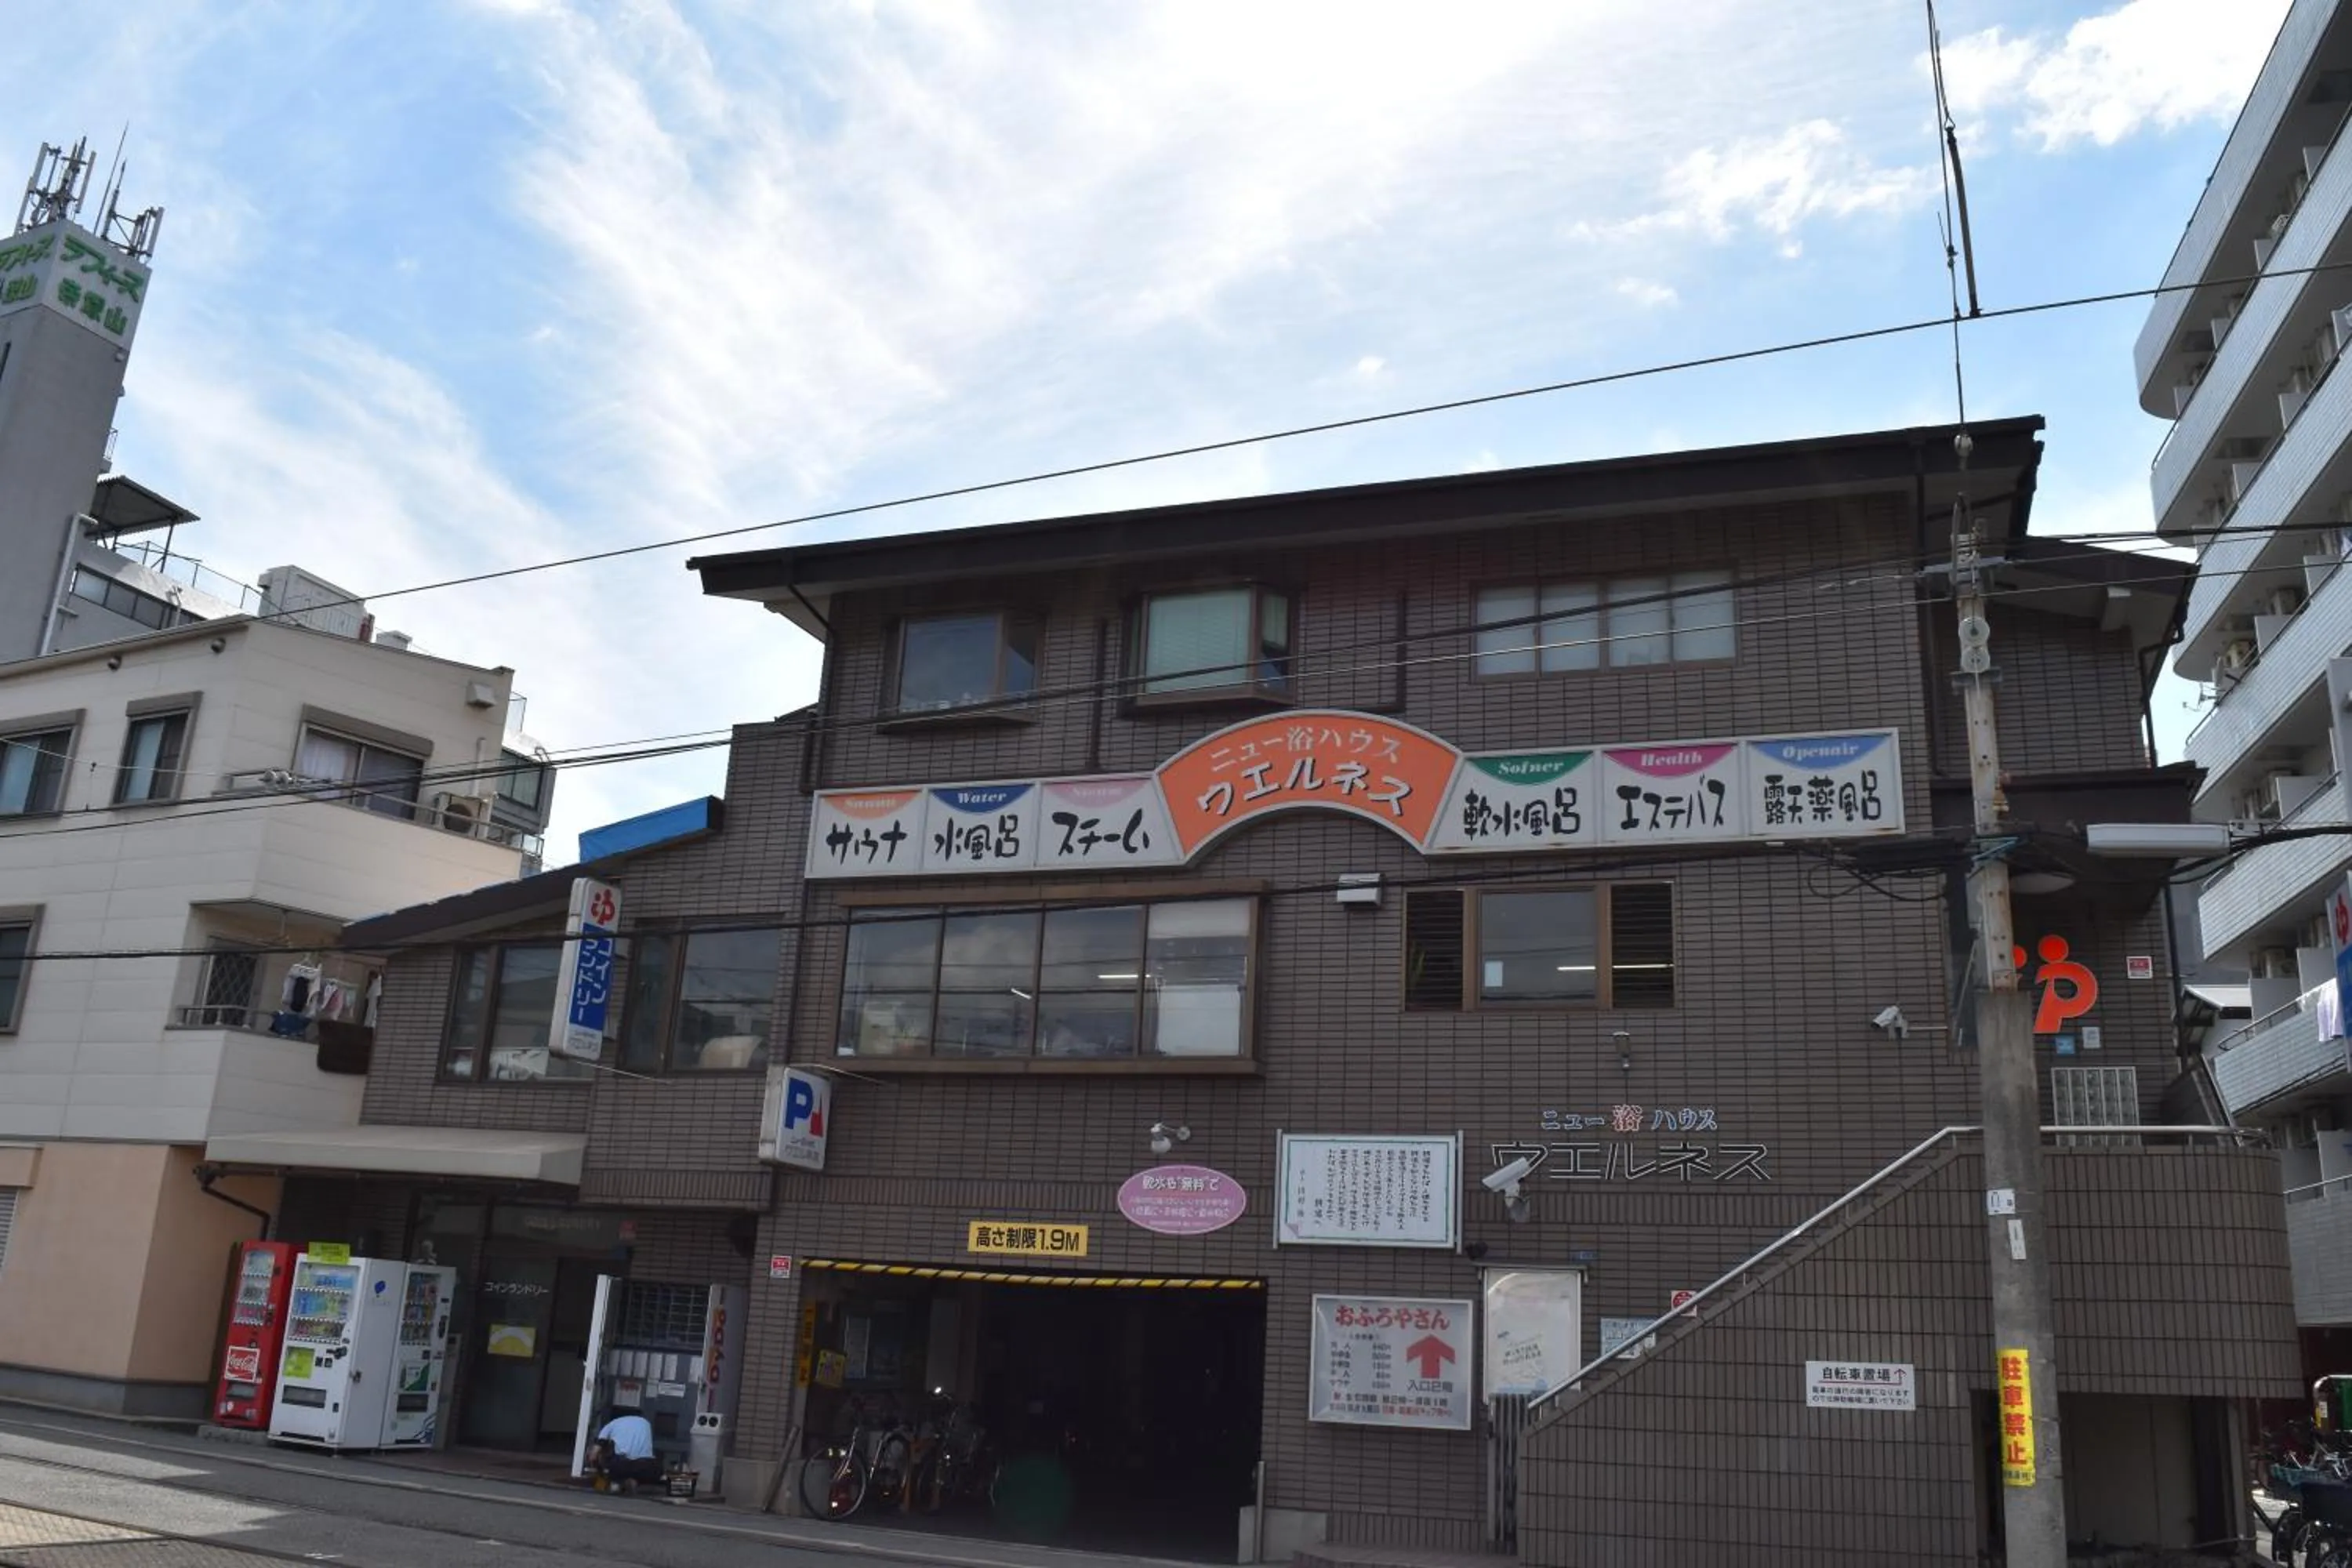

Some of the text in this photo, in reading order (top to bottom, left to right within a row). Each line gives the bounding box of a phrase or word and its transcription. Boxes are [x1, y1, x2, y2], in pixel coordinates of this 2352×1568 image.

[1210, 727, 1402, 771] ニュー浴ハウス
[1641, 753, 1703, 767] Health
[958, 791, 1007, 804] Water
[1197, 757, 1413, 816] ウエルネス
[1617, 774, 1725, 831] エステバス
[1765, 770, 1881, 825] 露天薬風呂
[1051, 808, 1150, 857] スチーム
[1464, 787, 1581, 840] 軟水風呂
[826, 819, 908, 864] サウナ
[935, 814, 1019, 861] 水風呂
[785, 1077, 813, 1130] P
[1492, 1142, 1771, 1181] ウエルネス
[976, 1225, 1080, 1251] 高さ制限1.9M
[485, 1282, 549, 1297] コインランドリー
[1335, 1304, 1450, 1331] おふろやさん
[1822, 1367, 1890, 1382] 自転車置場
[2002, 1356, 2027, 1466] 駐車禁止
